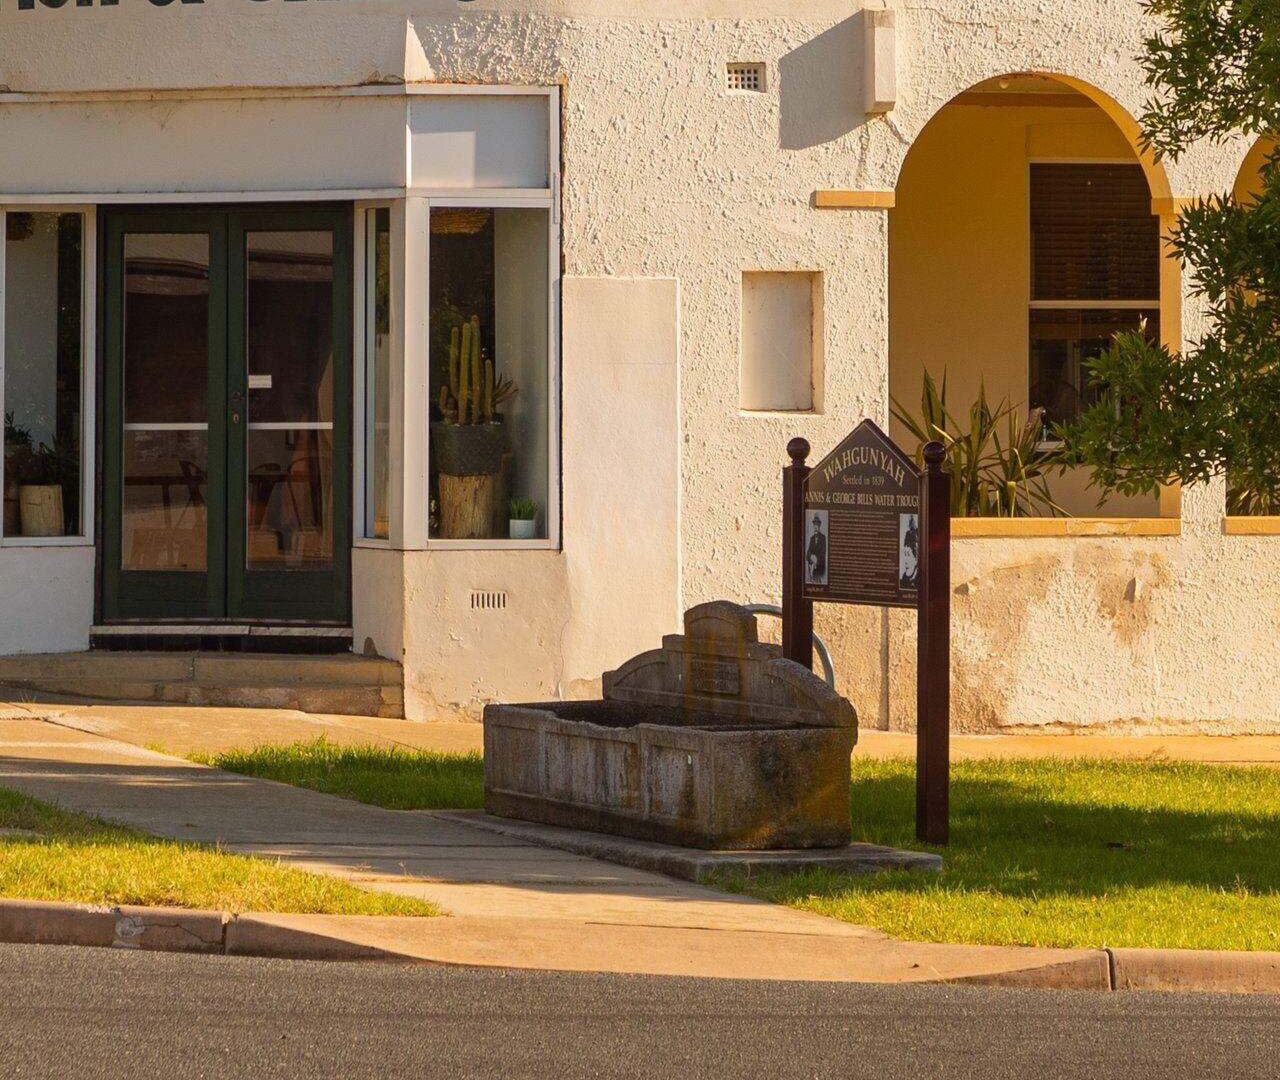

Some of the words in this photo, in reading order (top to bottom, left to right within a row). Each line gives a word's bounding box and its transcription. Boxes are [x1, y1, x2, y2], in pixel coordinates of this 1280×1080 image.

[823, 446, 905, 488] WAHGUNYAH
[842, 474, 862, 486] Settled
[863, 476, 870, 486] in
[826, 491, 831, 503] &
[832, 491, 856, 504] GEORGE
[857, 492, 873, 506] BILLS
[874, 493, 895, 507] WATER
